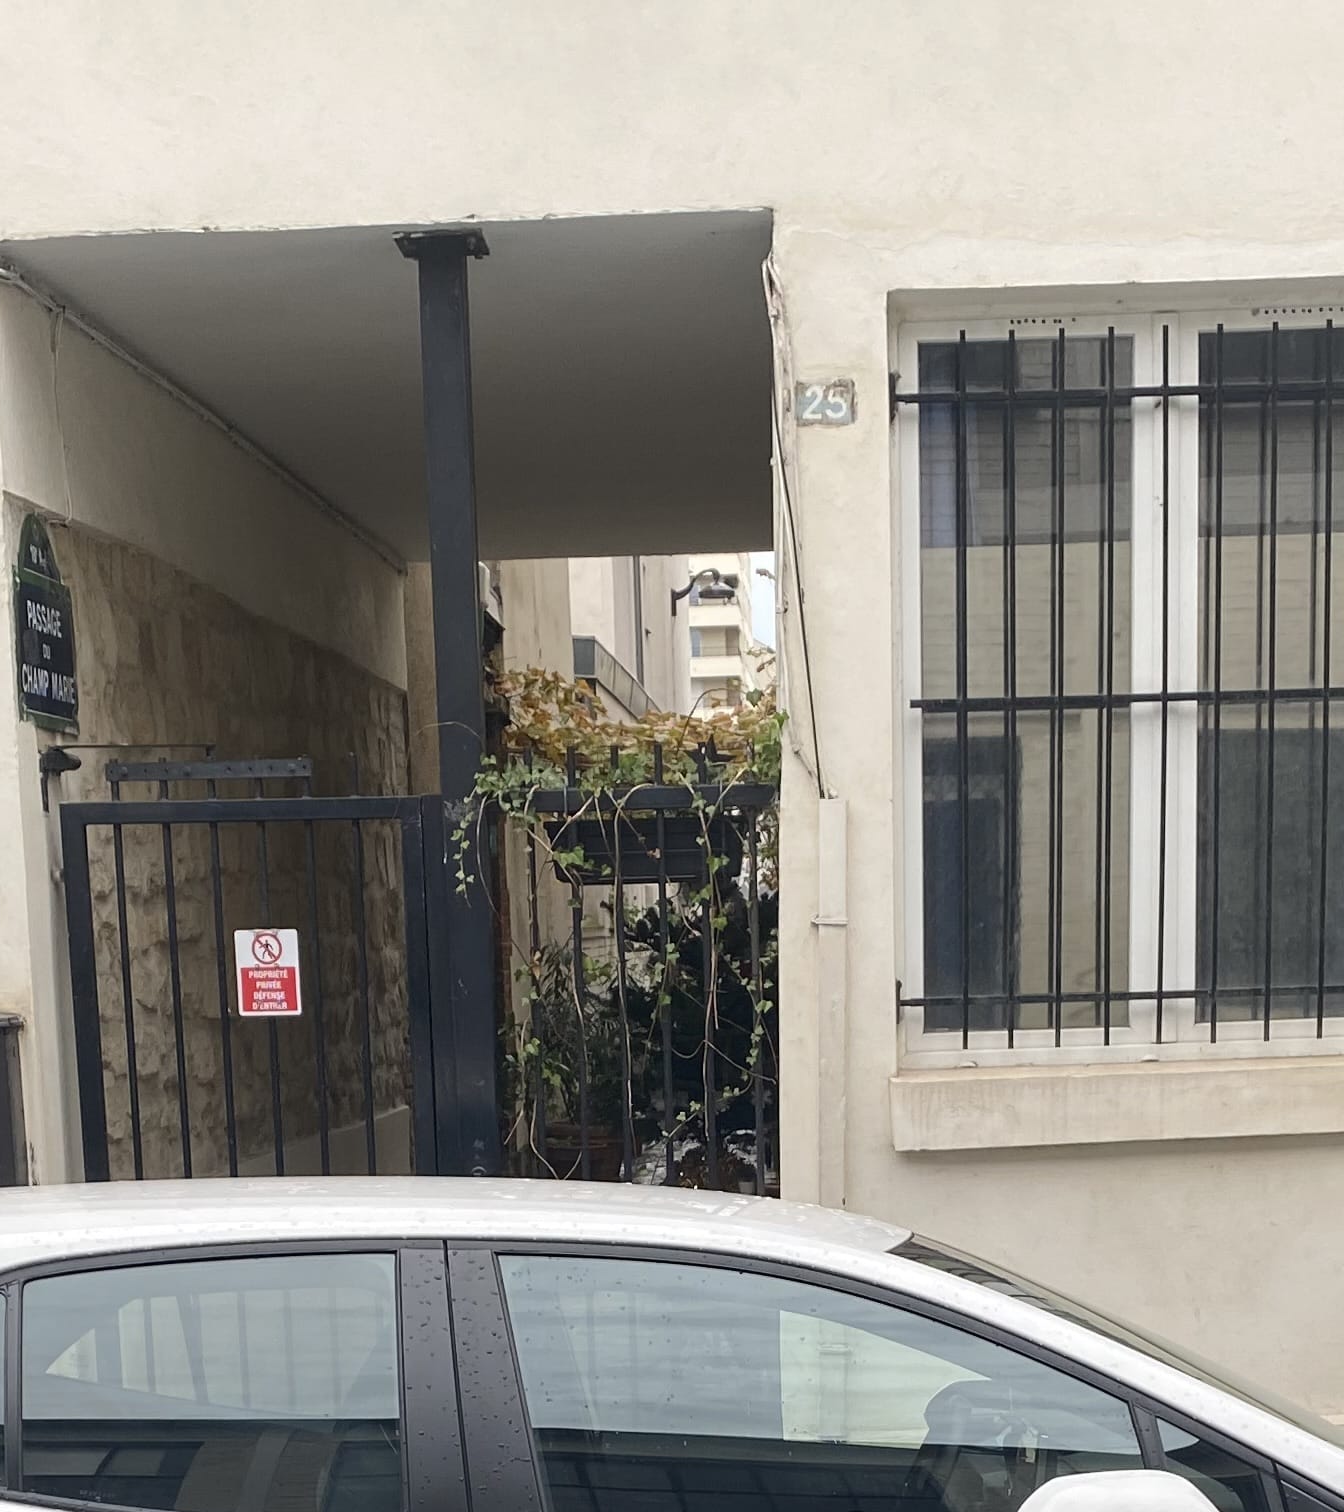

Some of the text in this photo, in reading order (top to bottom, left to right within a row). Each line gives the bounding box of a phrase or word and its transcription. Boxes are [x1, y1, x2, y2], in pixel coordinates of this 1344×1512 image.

[802, 385, 846, 420] 25
[26, 599, 62, 639] PASSAGE
[42, 643, 51, 660] DU
[21, 663, 76, 704] CHAMP MARIE
